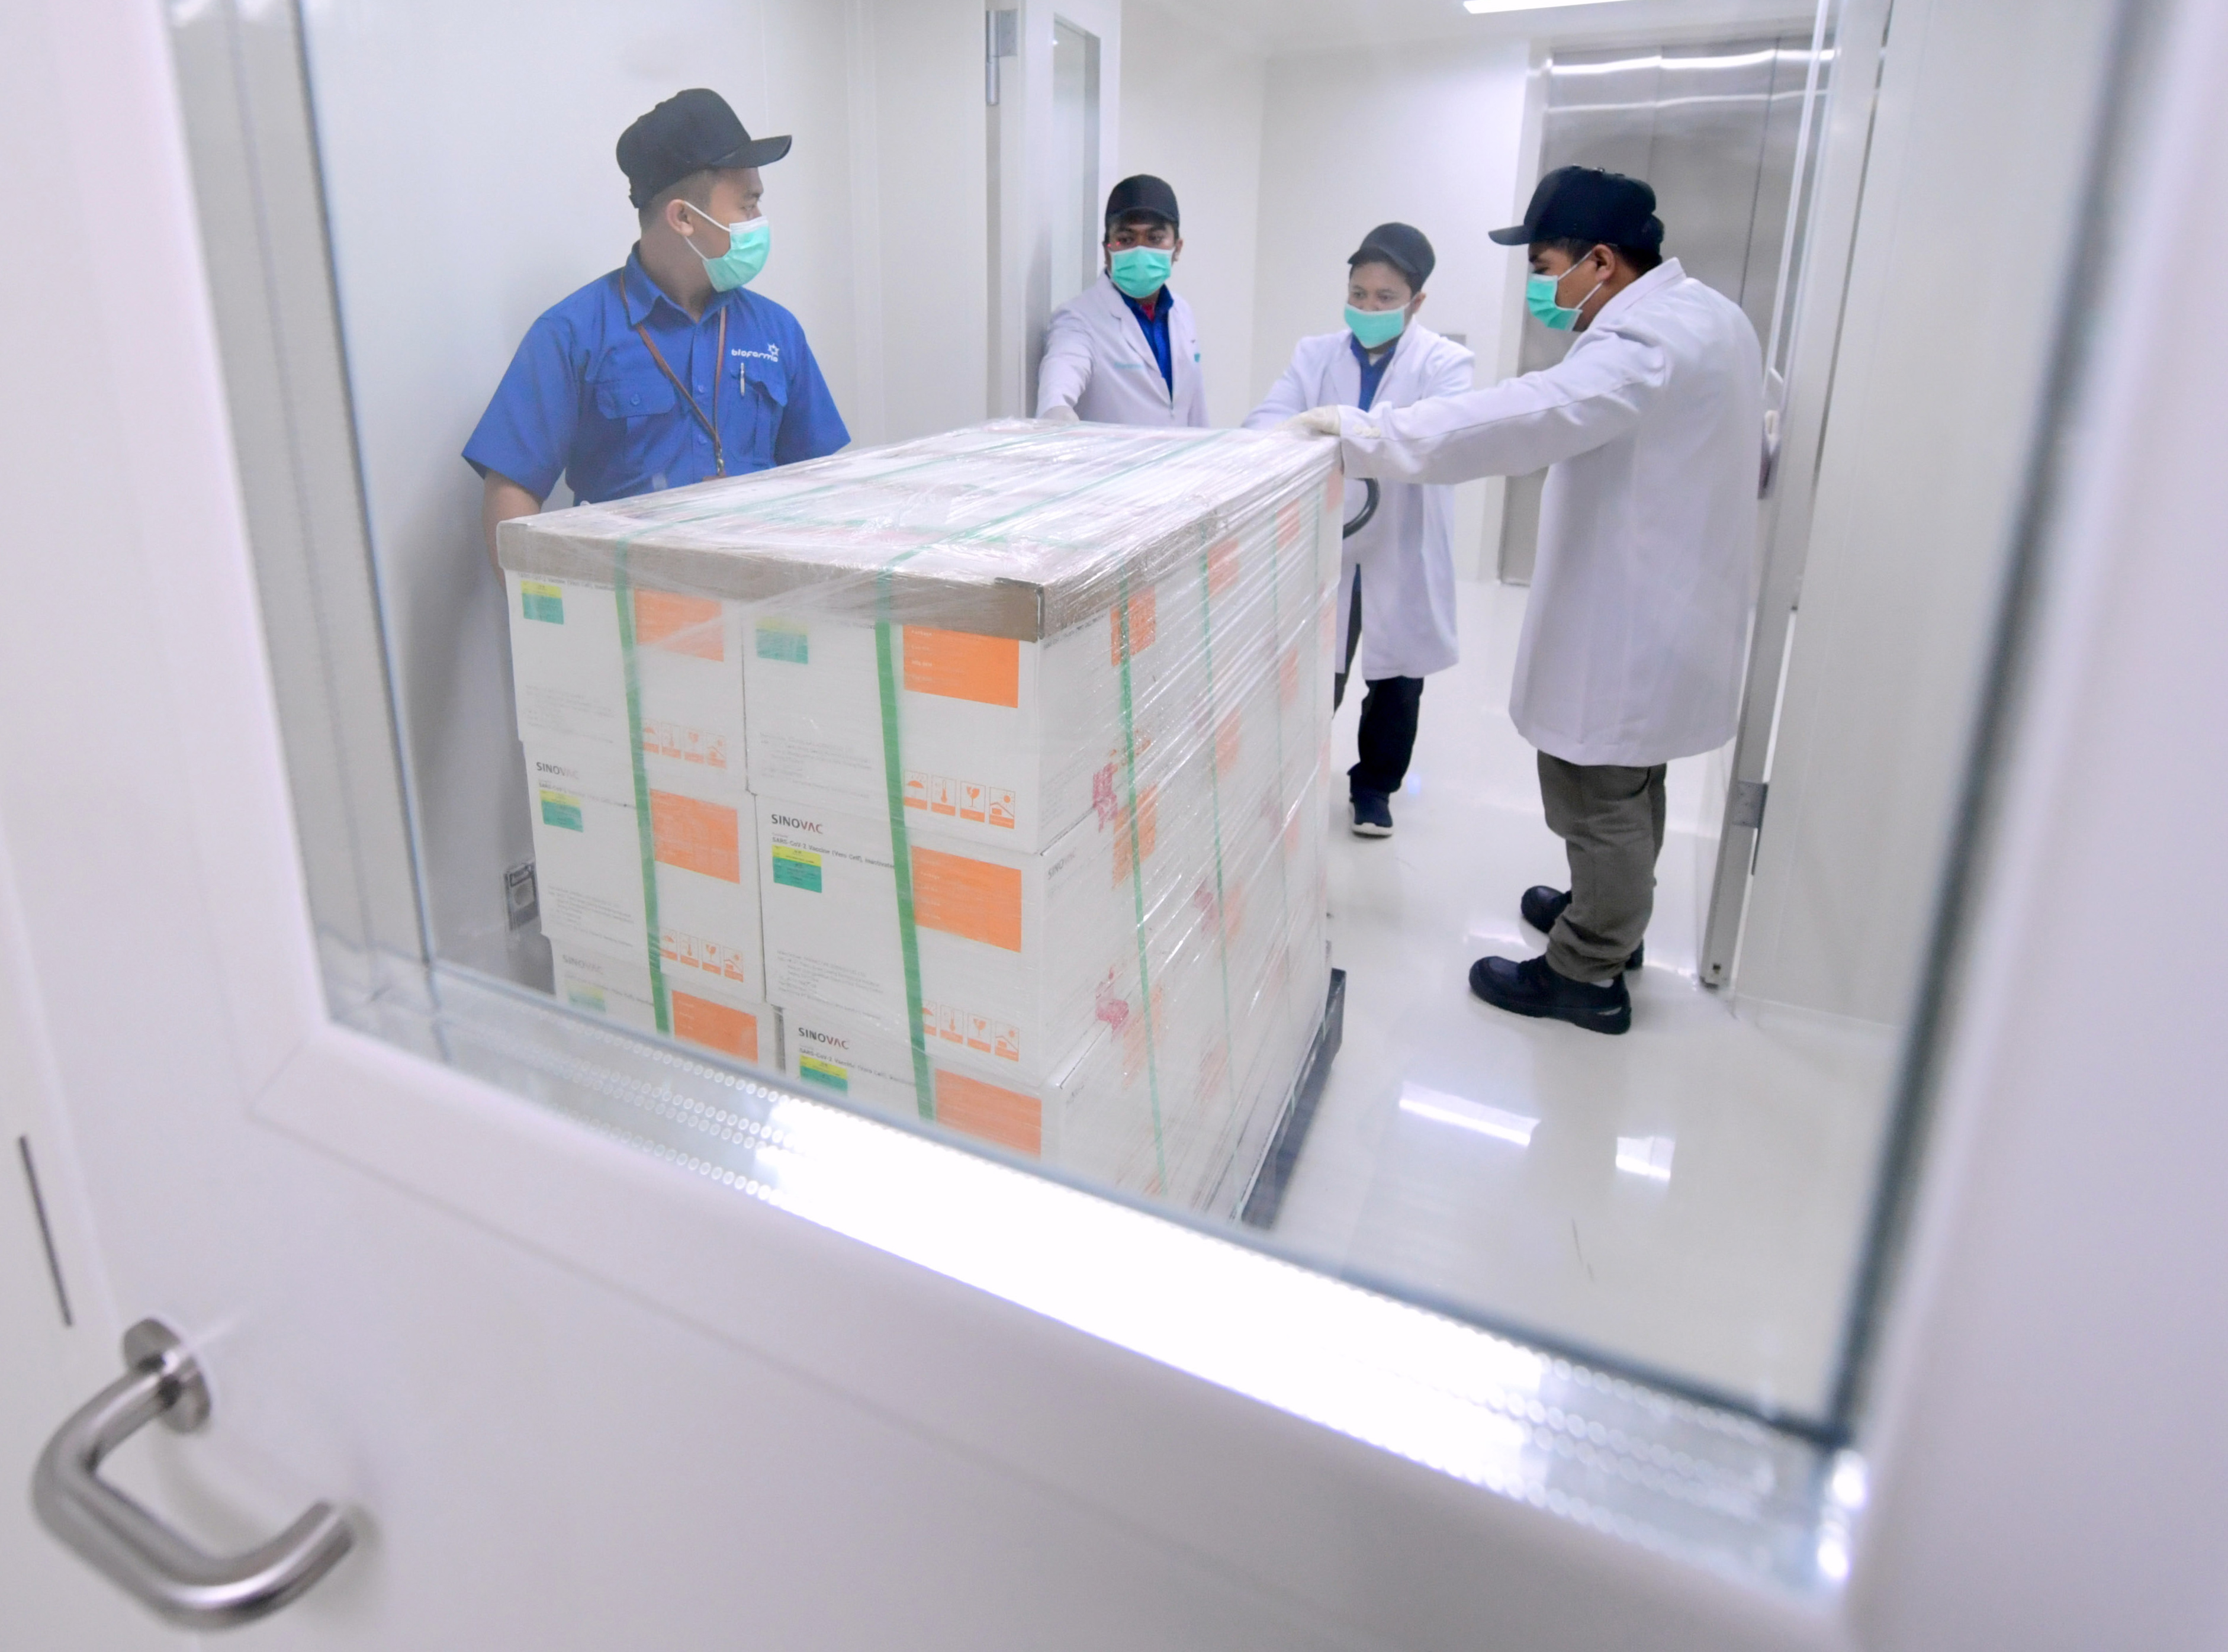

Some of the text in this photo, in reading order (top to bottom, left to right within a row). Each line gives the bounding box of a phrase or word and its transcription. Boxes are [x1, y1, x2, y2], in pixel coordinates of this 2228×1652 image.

[731, 348, 778, 362] biofarma
[771, 814, 824, 834] SINOVAC
[798, 1027, 850, 1050] SINOVAC
